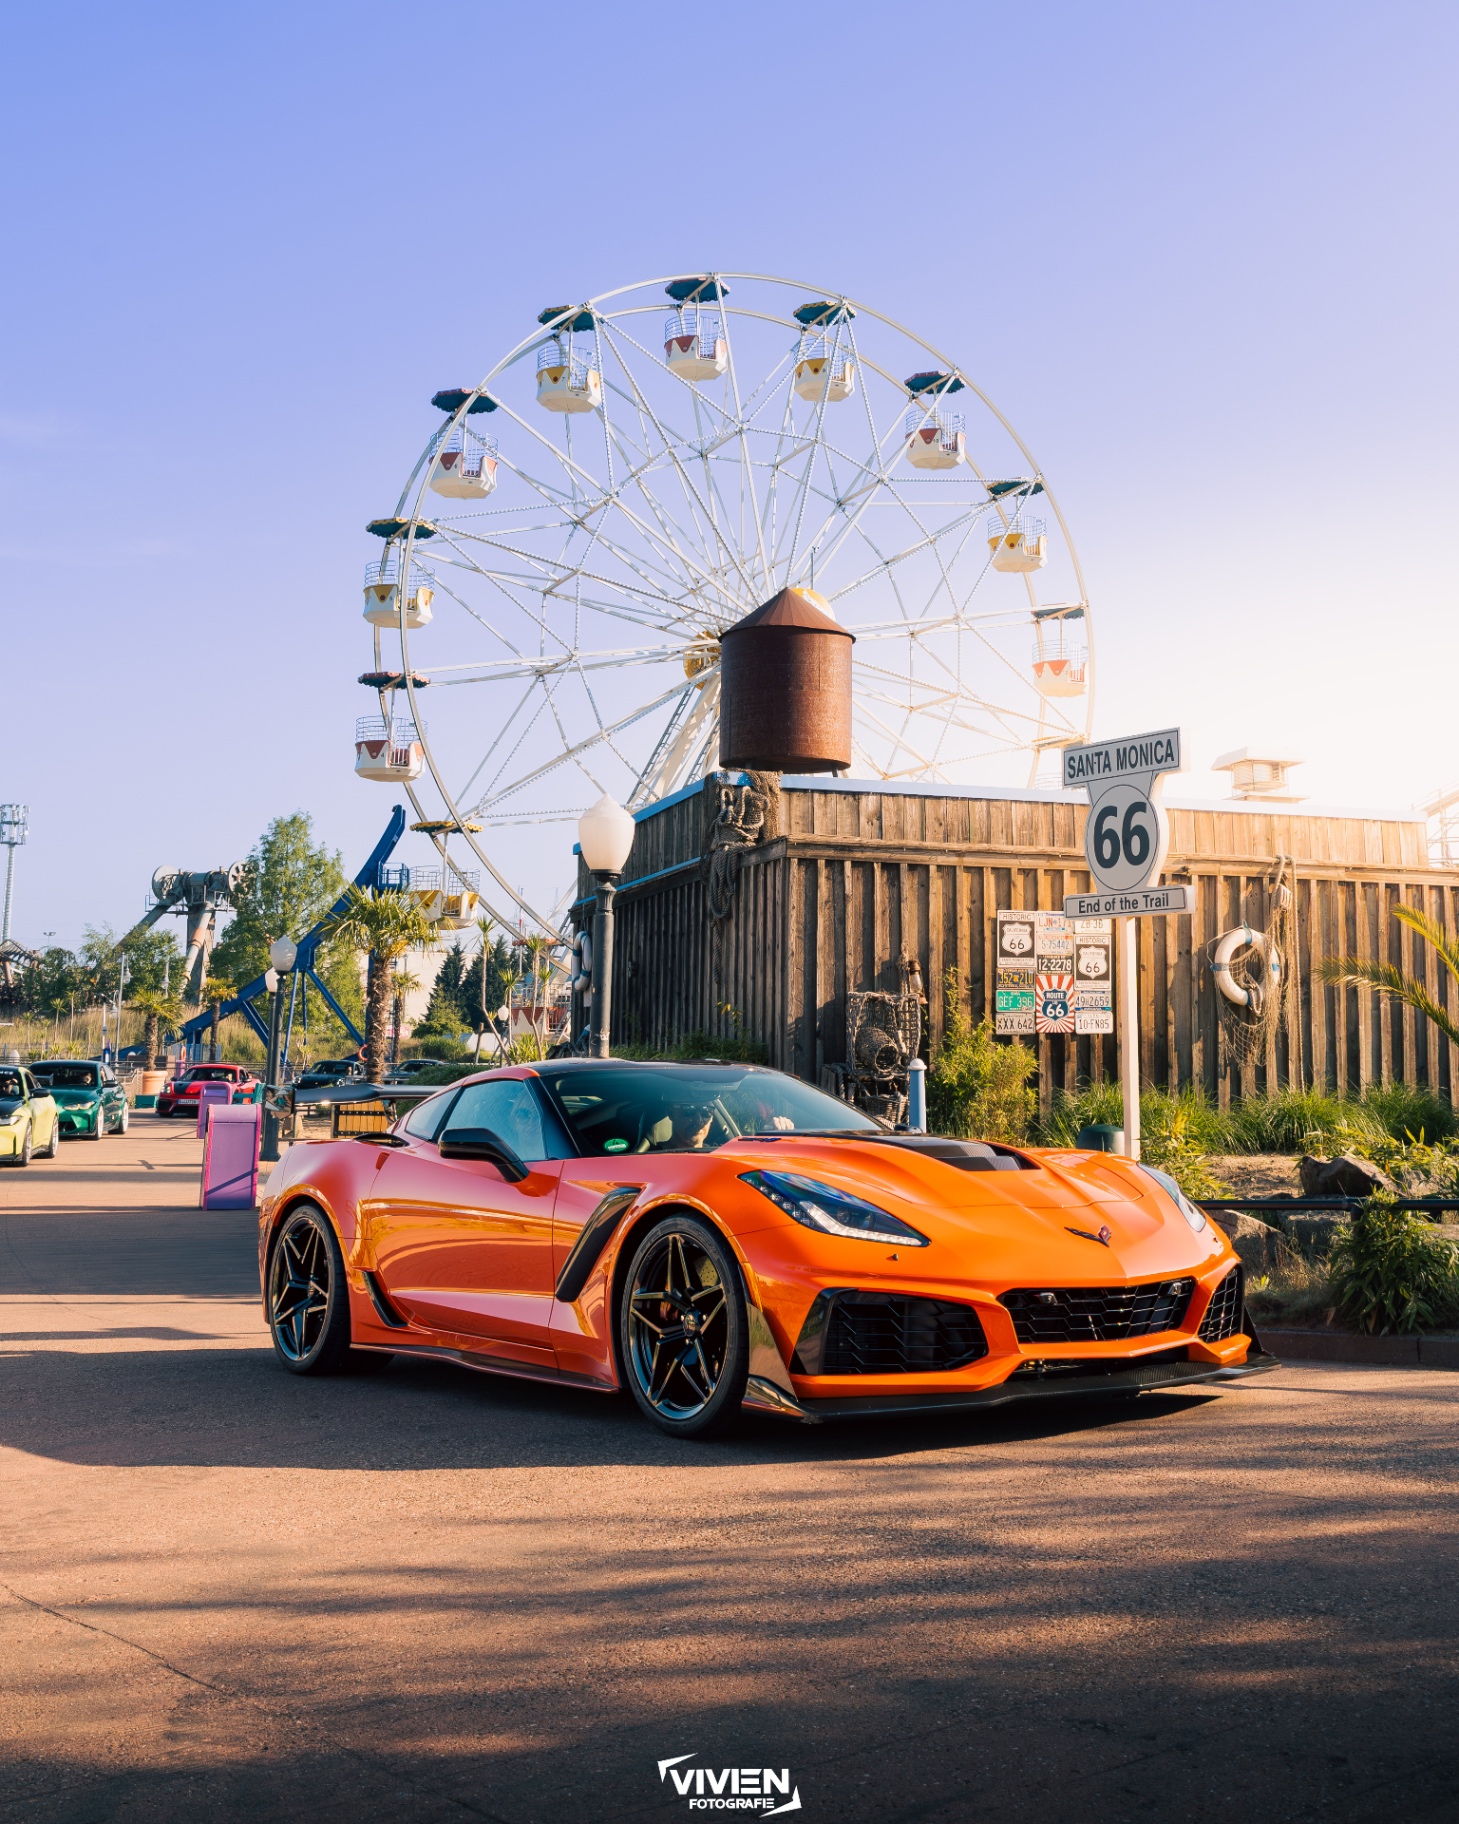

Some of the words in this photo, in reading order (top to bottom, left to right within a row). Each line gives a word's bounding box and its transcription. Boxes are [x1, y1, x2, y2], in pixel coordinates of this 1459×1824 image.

[1068, 750, 1112, 779] SANTA
[1116, 739, 1175, 771] MONICA
[1094, 801, 1150, 869] 66
[1078, 898, 1100, 914] End
[1104, 897, 1116, 912] of
[1120, 896, 1139, 910] the
[1142, 892, 1169, 909] Trail
[1009, 938, 1025, 950] 66
[1085, 961, 1101, 973] 66
[1046, 992, 1065, 1000] ROUTE
[1046, 1003, 1065, 1018] 66
[1017, 1018, 1034, 1030] 642
